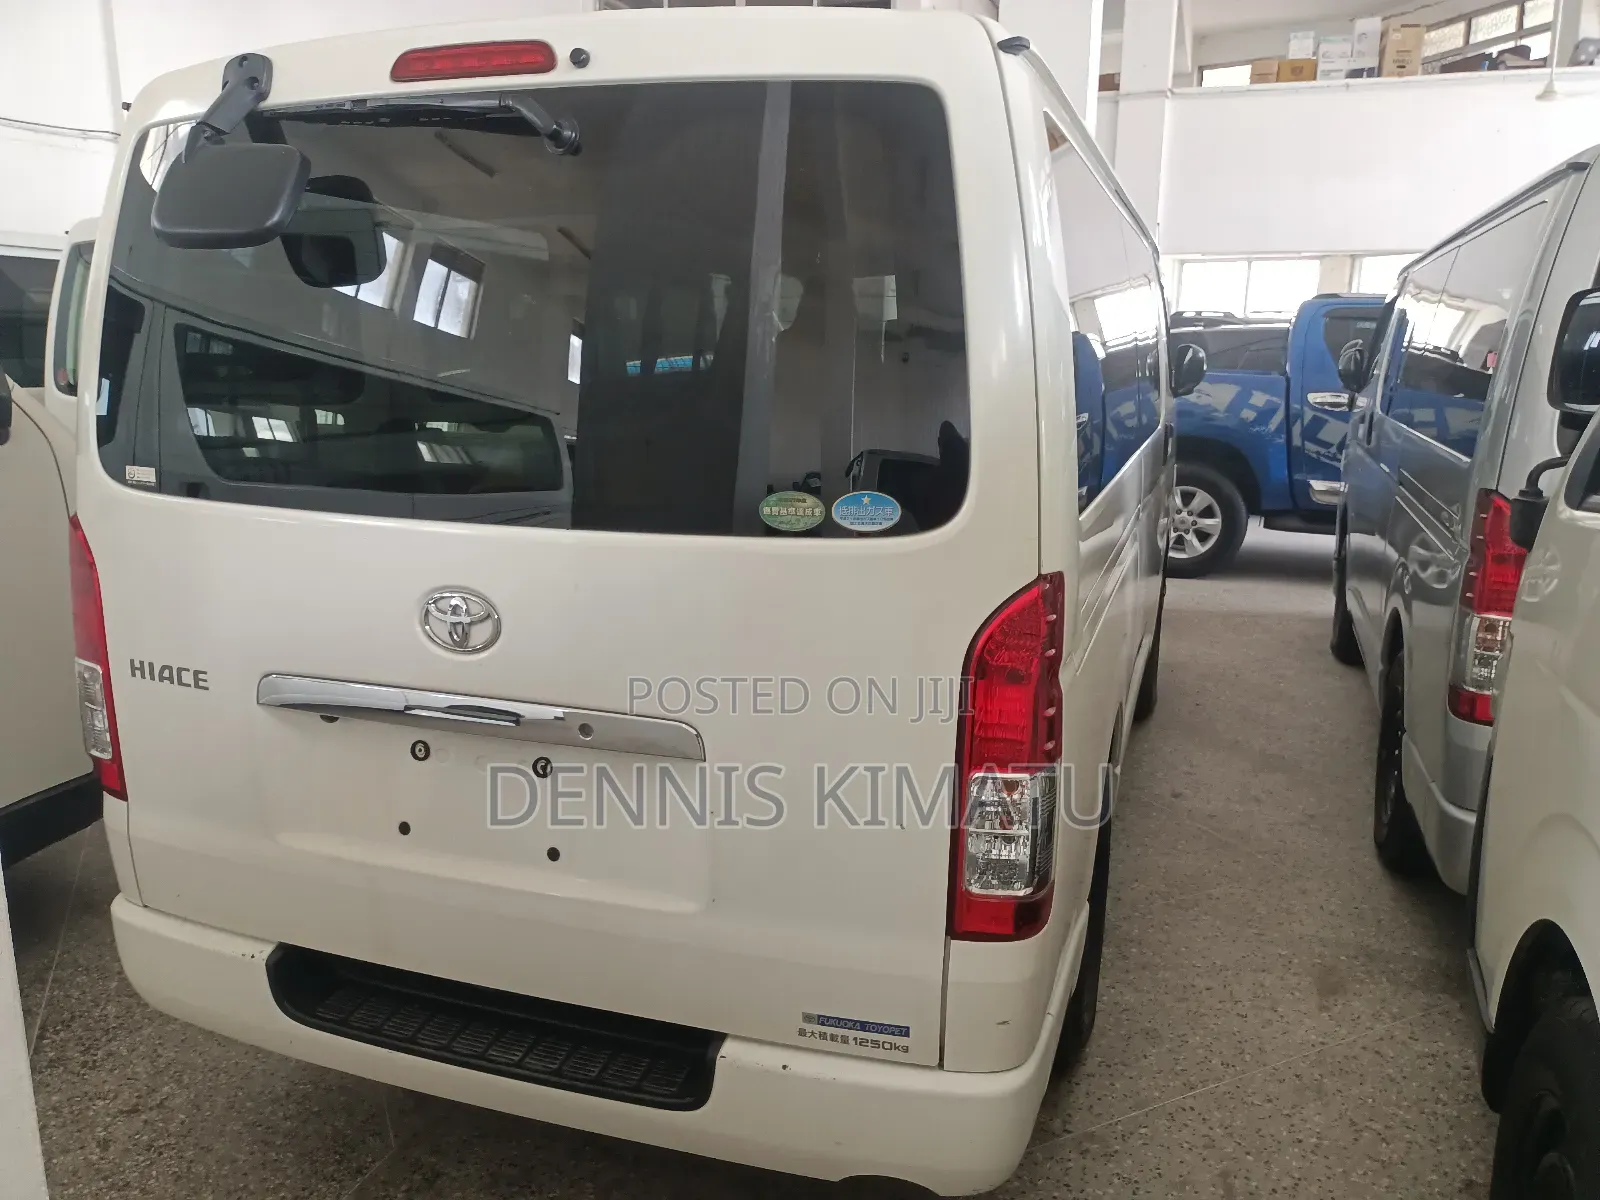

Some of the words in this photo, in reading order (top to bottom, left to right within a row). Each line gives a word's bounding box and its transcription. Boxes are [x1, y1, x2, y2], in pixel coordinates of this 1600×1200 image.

[839, 505, 894, 516] 低排出ガス車
[129, 658, 210, 691] HIACE
[819, 1016, 860, 1030] FUKUOKA
[865, 1023, 907, 1036] TOYOPET
